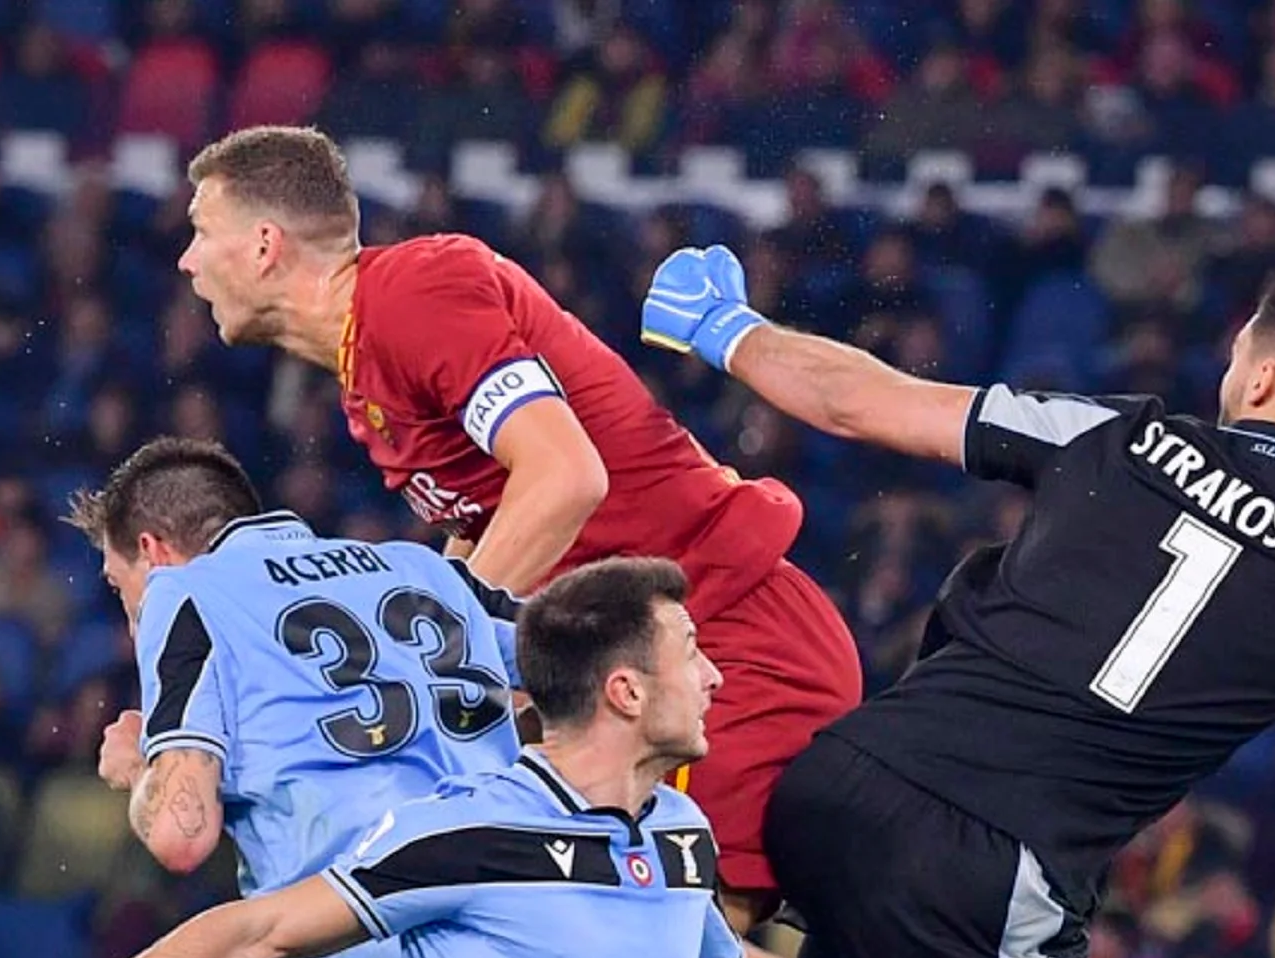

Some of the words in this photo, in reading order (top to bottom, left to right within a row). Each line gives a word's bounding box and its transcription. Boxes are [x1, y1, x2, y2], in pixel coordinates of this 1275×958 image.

[264, 546, 393, 586] ACERBI
[1089, 511, 1244, 714] 1
[275, 586, 511, 761] 33
